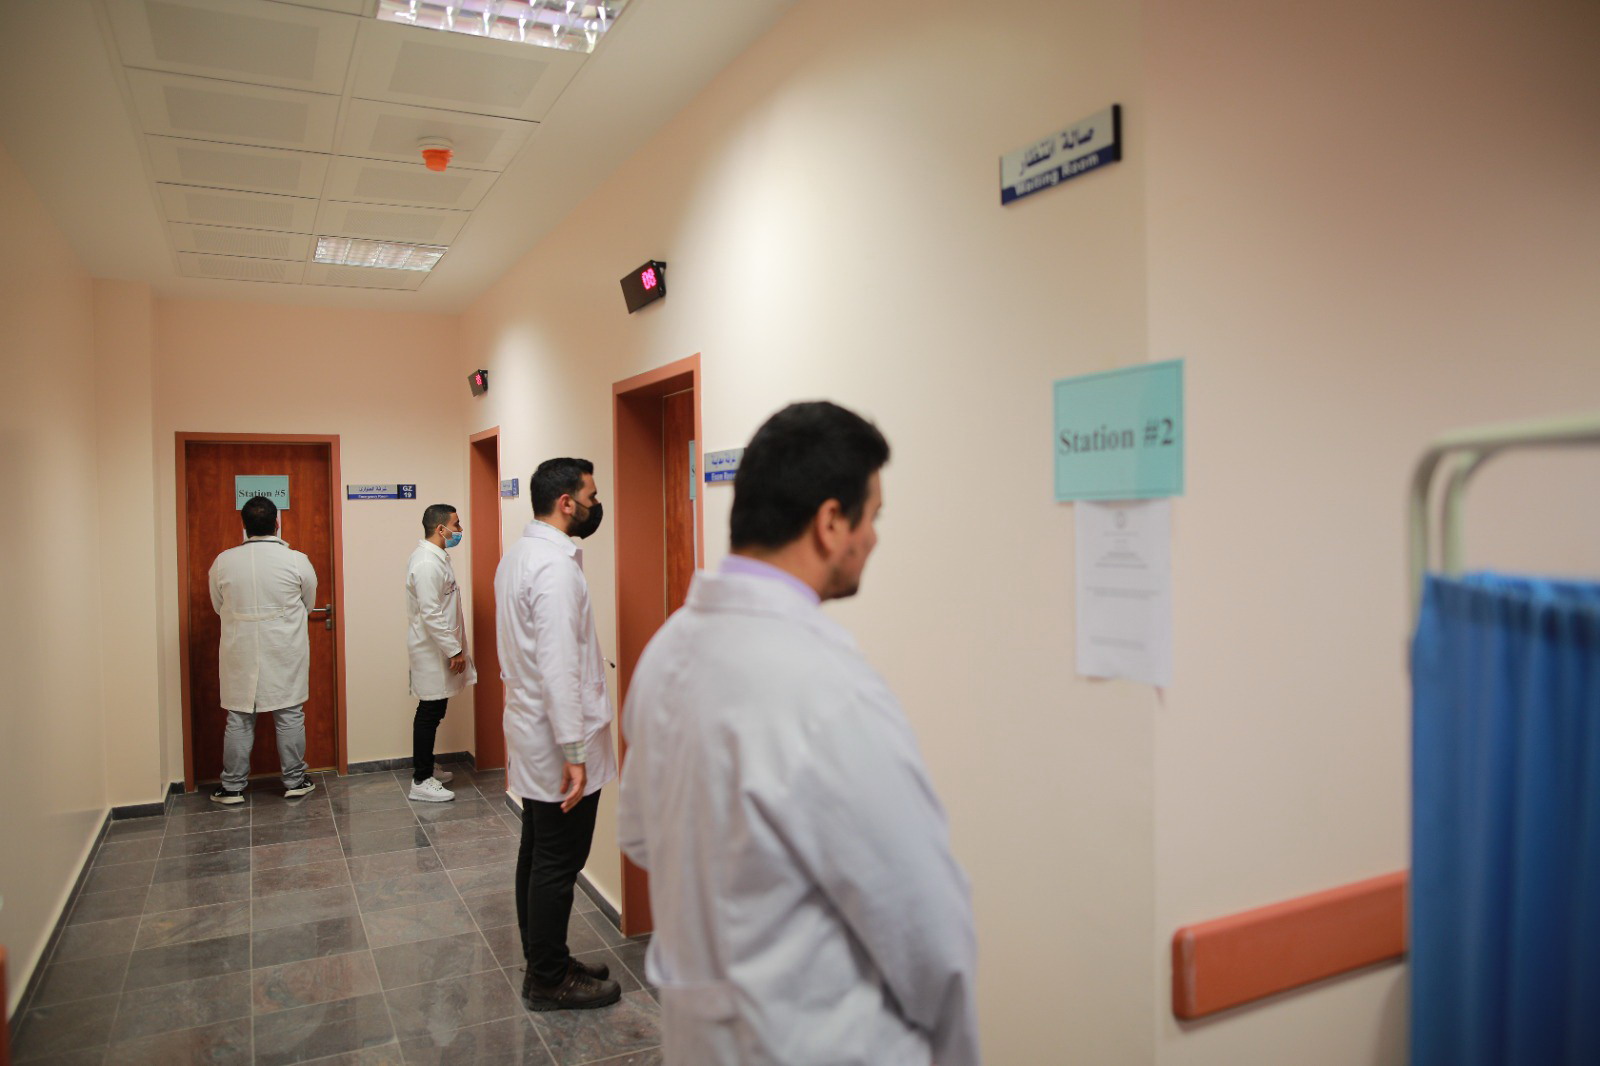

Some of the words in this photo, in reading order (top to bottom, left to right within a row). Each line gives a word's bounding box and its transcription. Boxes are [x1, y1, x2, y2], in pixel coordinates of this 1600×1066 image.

[1015, 168, 1060, 196] Waiting
[1062, 152, 1100, 178] Room
[1059, 424, 1135, 455] Station
[1143, 417, 1173, 448] #2
[238, 489, 272, 498] Station
[274, 489, 286, 498] #5
